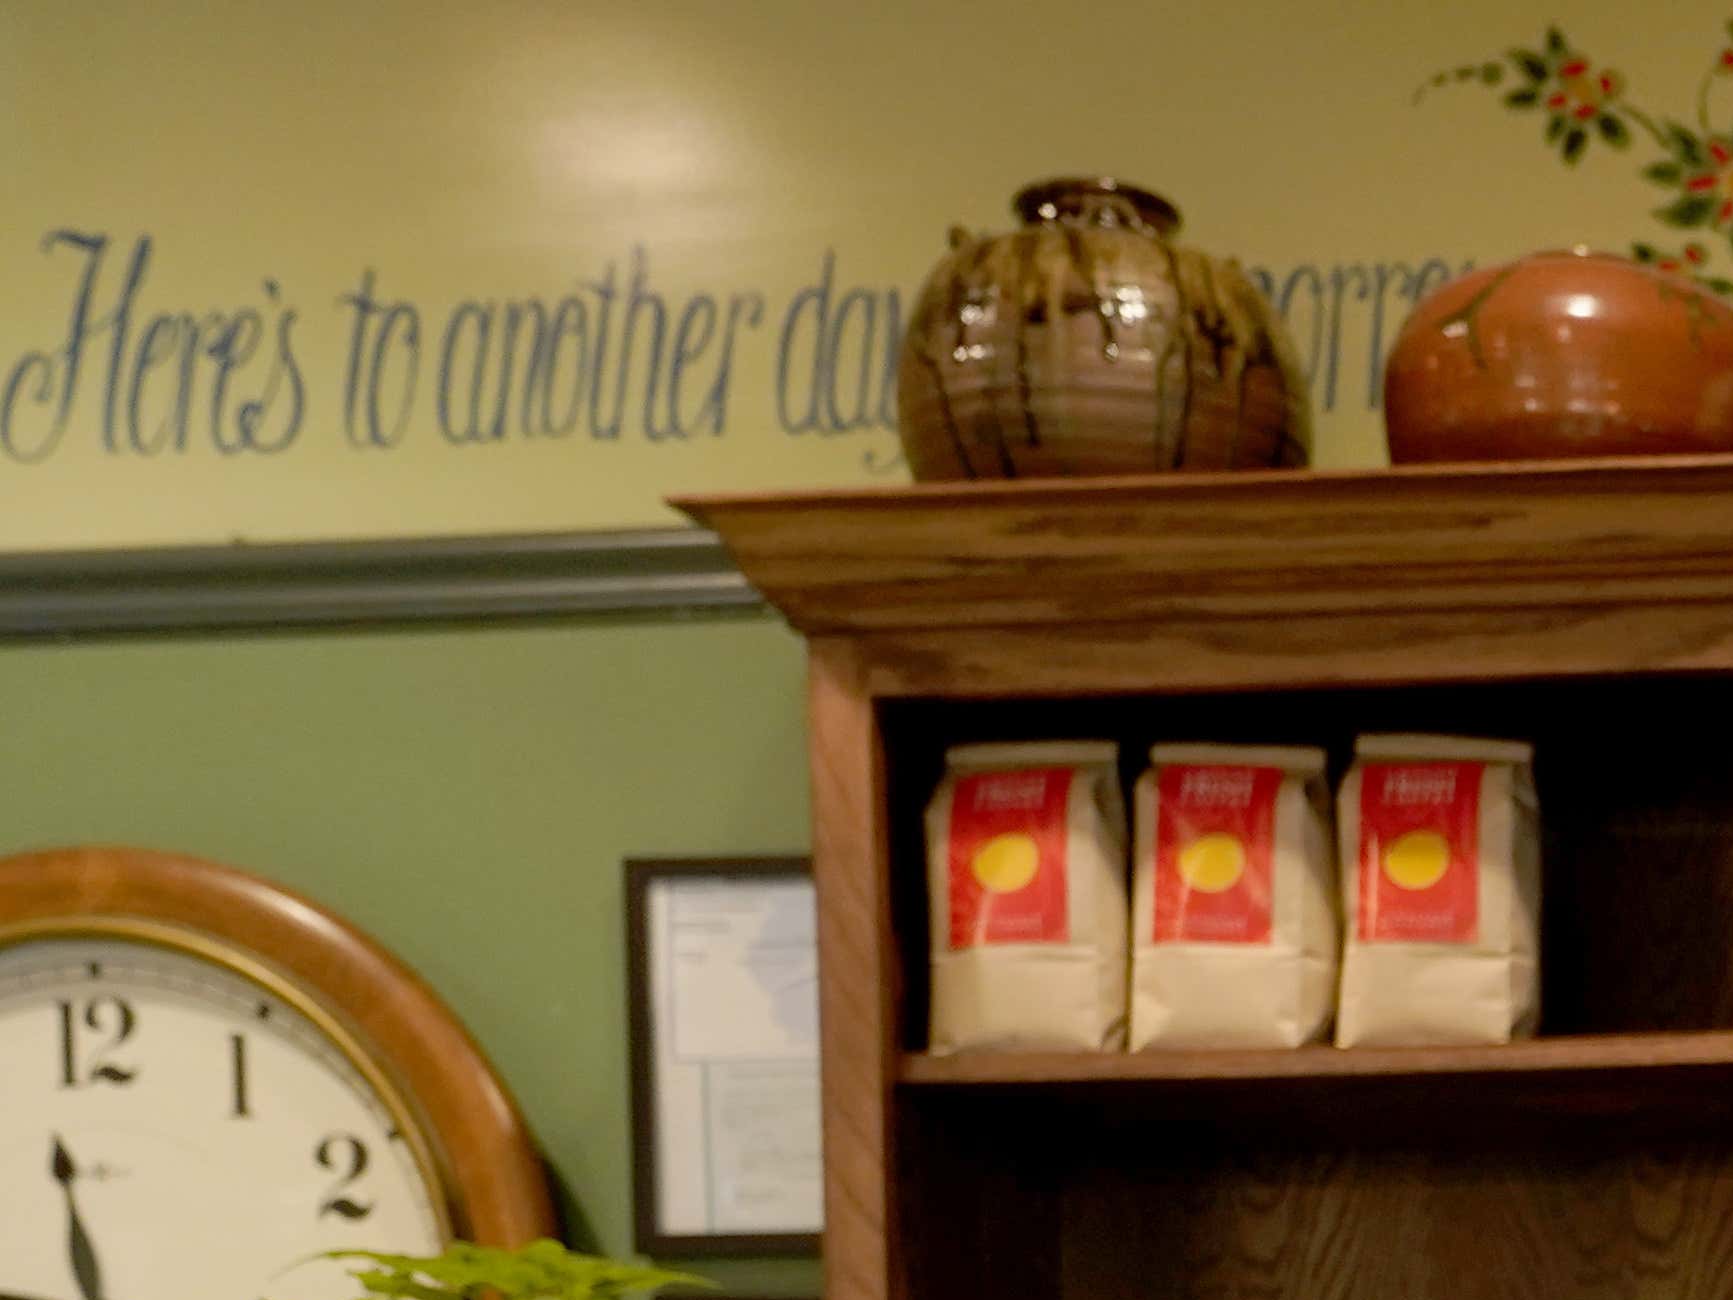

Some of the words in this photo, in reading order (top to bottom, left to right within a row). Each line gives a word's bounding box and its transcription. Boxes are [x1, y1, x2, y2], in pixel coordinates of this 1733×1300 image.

[2, 228, 305, 462] Here's
[341, 268, 417, 448] to
[440, 245, 764, 450] another
[58, 998, 138, 1088] 12
[230, 1033, 252, 1119] 1
[314, 1130, 375, 1221] 2
